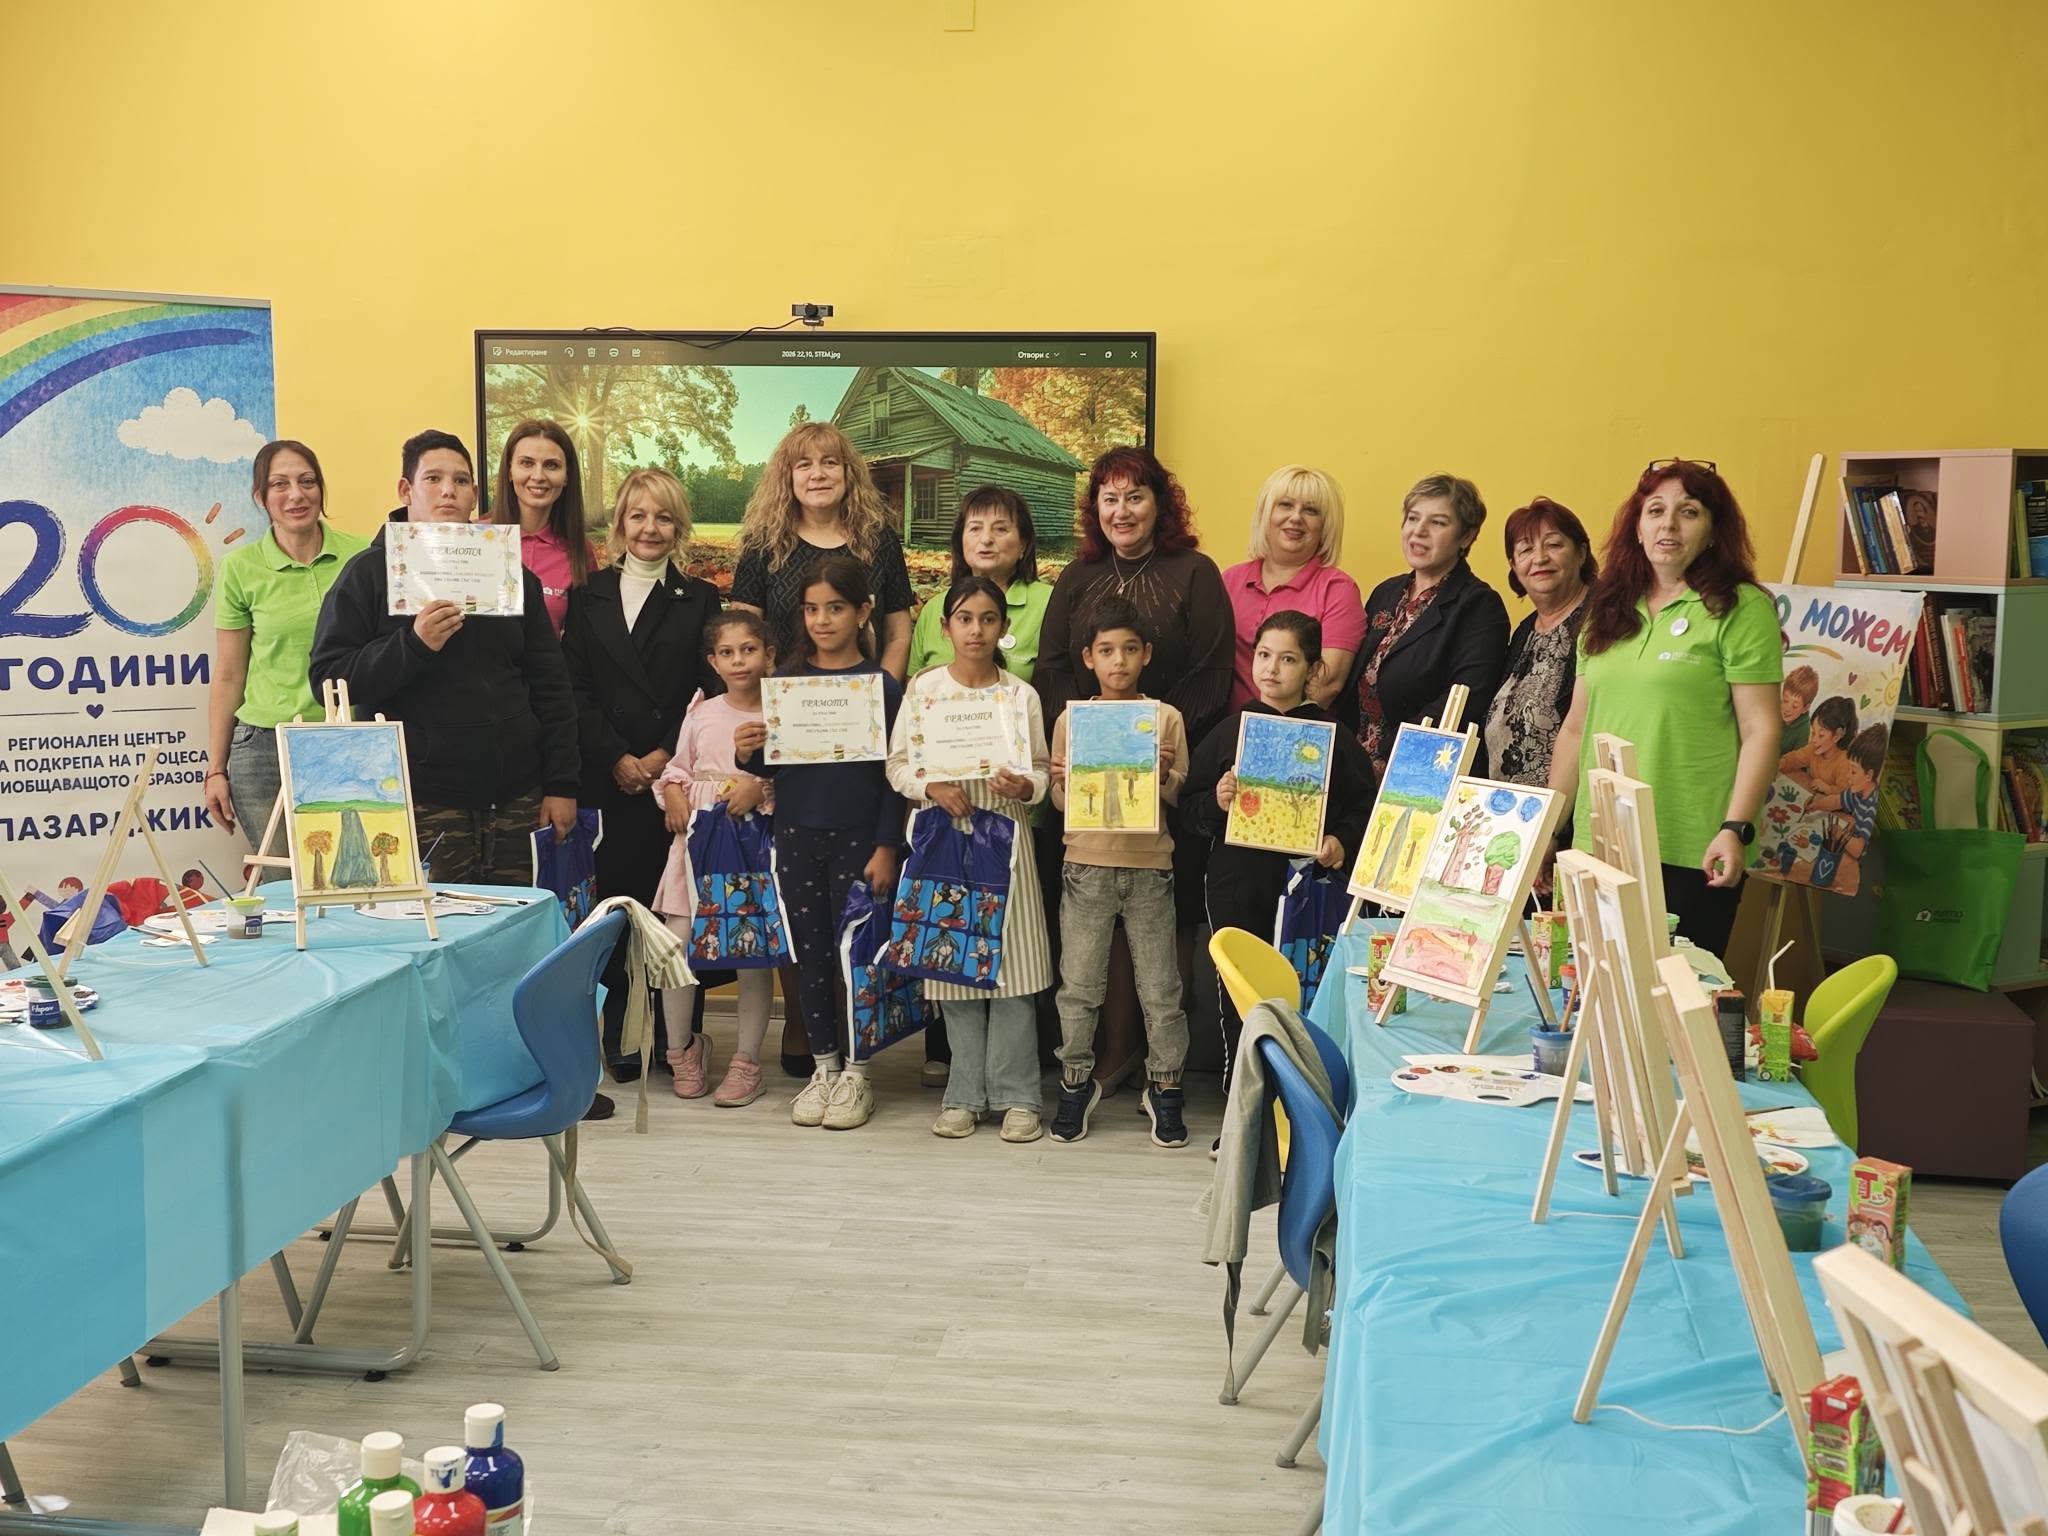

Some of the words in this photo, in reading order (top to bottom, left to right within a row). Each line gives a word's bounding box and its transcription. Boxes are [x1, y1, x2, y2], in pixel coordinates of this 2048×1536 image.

[505, 348, 548, 358] Редактиране
[1017, 351, 1044, 360] Отвори
[0, 499, 214, 639] 20
[0, 652, 211, 695] ГОДИНИ
[8, 733, 119, 751] РЕГИОНАЛЕН
[124, 731, 187, 747] ЦЕНТЪР
[0, 760, 9, 773] А
[14, 755, 105, 773] ПОДКРЕПА
[109, 753, 131, 767] НА
[136, 750, 209, 767] ПОЦЕСА
[1, 775, 130, 794] ИОБЩАВАЩОТО
